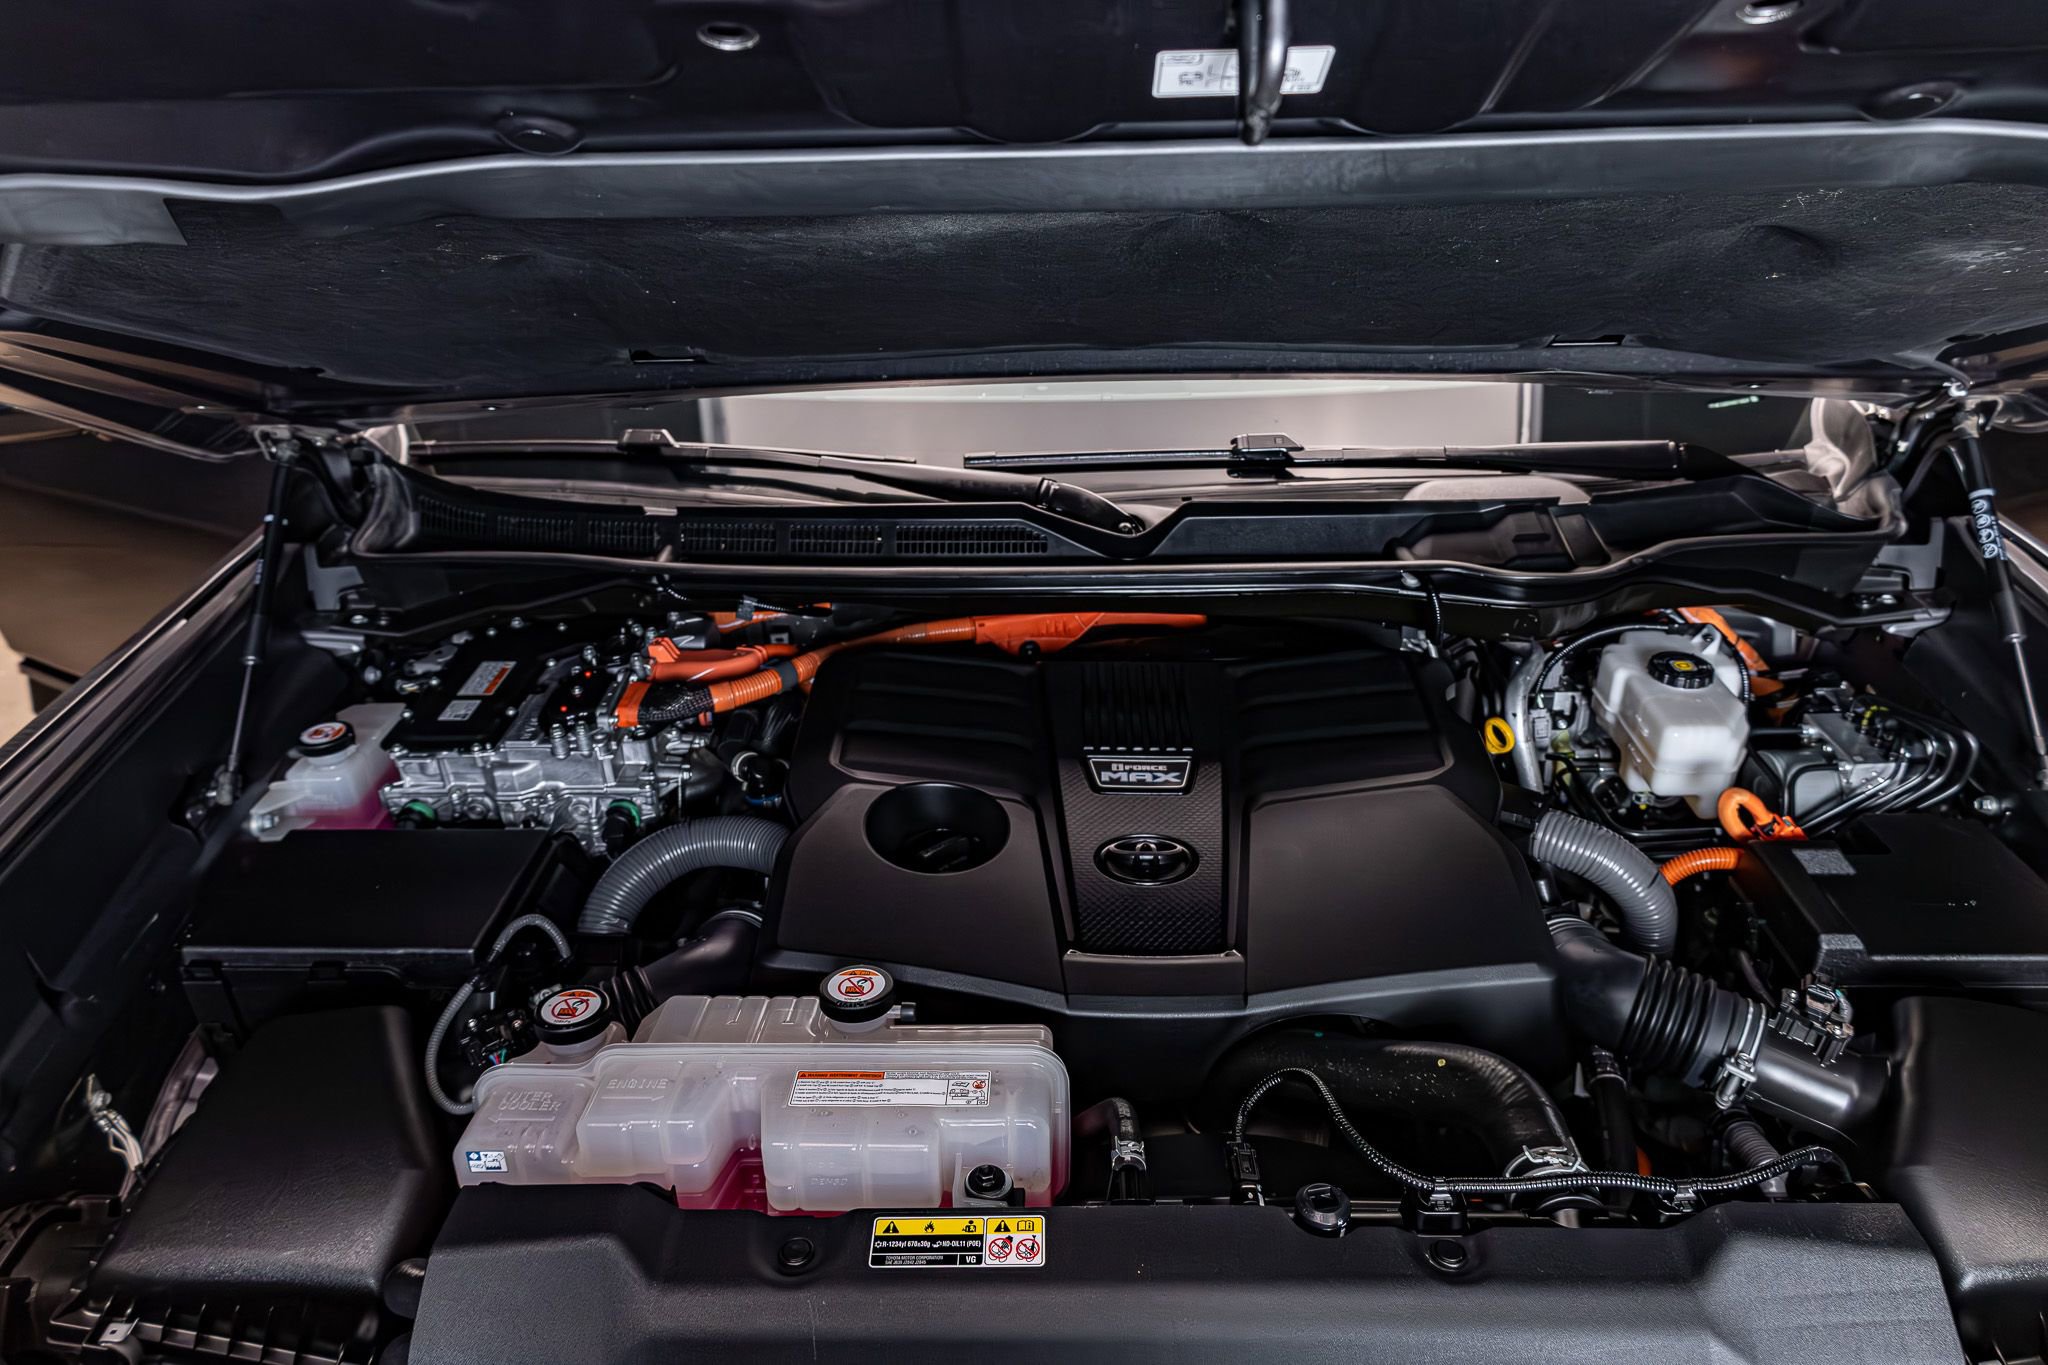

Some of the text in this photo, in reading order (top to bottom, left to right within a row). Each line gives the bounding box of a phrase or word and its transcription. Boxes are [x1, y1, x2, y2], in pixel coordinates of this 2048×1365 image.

[1100, 771, 1182, 783] MAX
[606, 1078, 669, 1089] ENGINE
[498, 1101, 562, 1111] COOLER
[965, 1255, 977, 1264] VG
